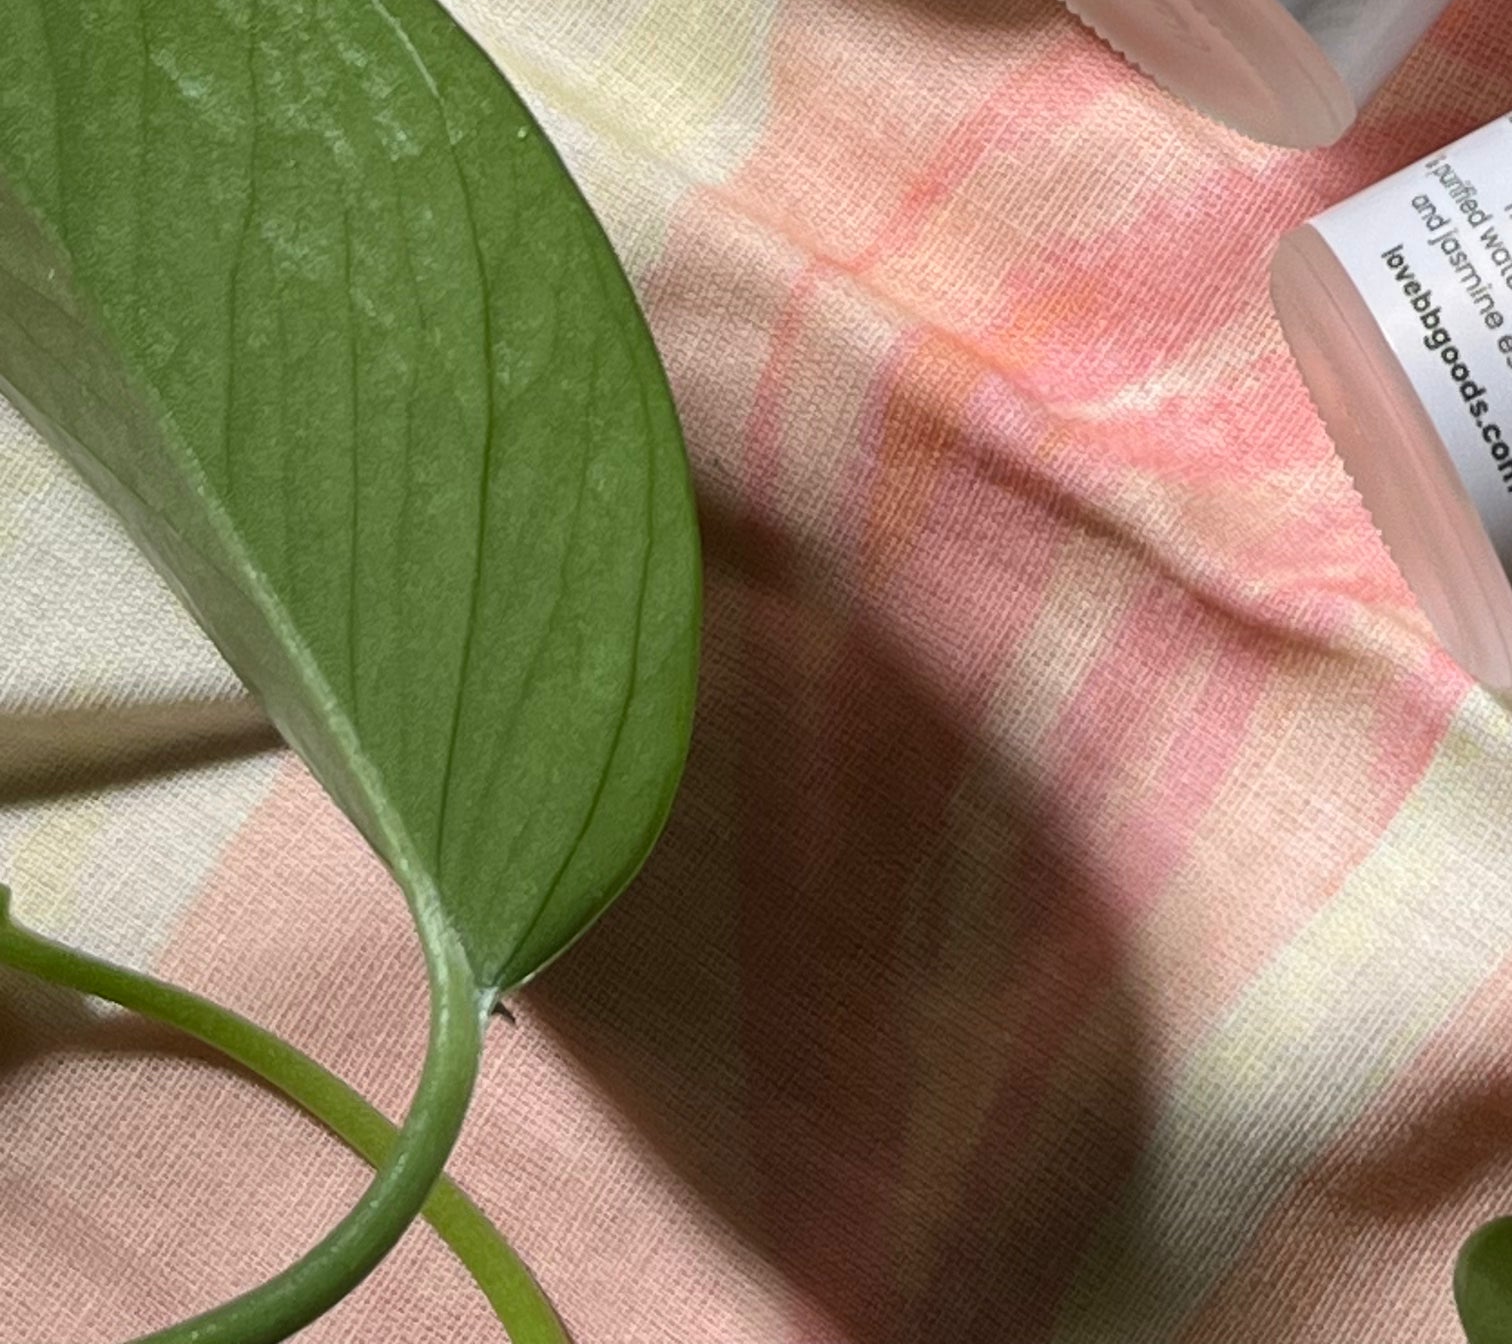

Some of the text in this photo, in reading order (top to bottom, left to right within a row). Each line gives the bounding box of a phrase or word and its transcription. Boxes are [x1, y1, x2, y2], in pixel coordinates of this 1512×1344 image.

[1411, 194, 1451, 232] and
[1425, 163, 1493, 228] purified
[1427, 227, 1505, 330] jasmine
